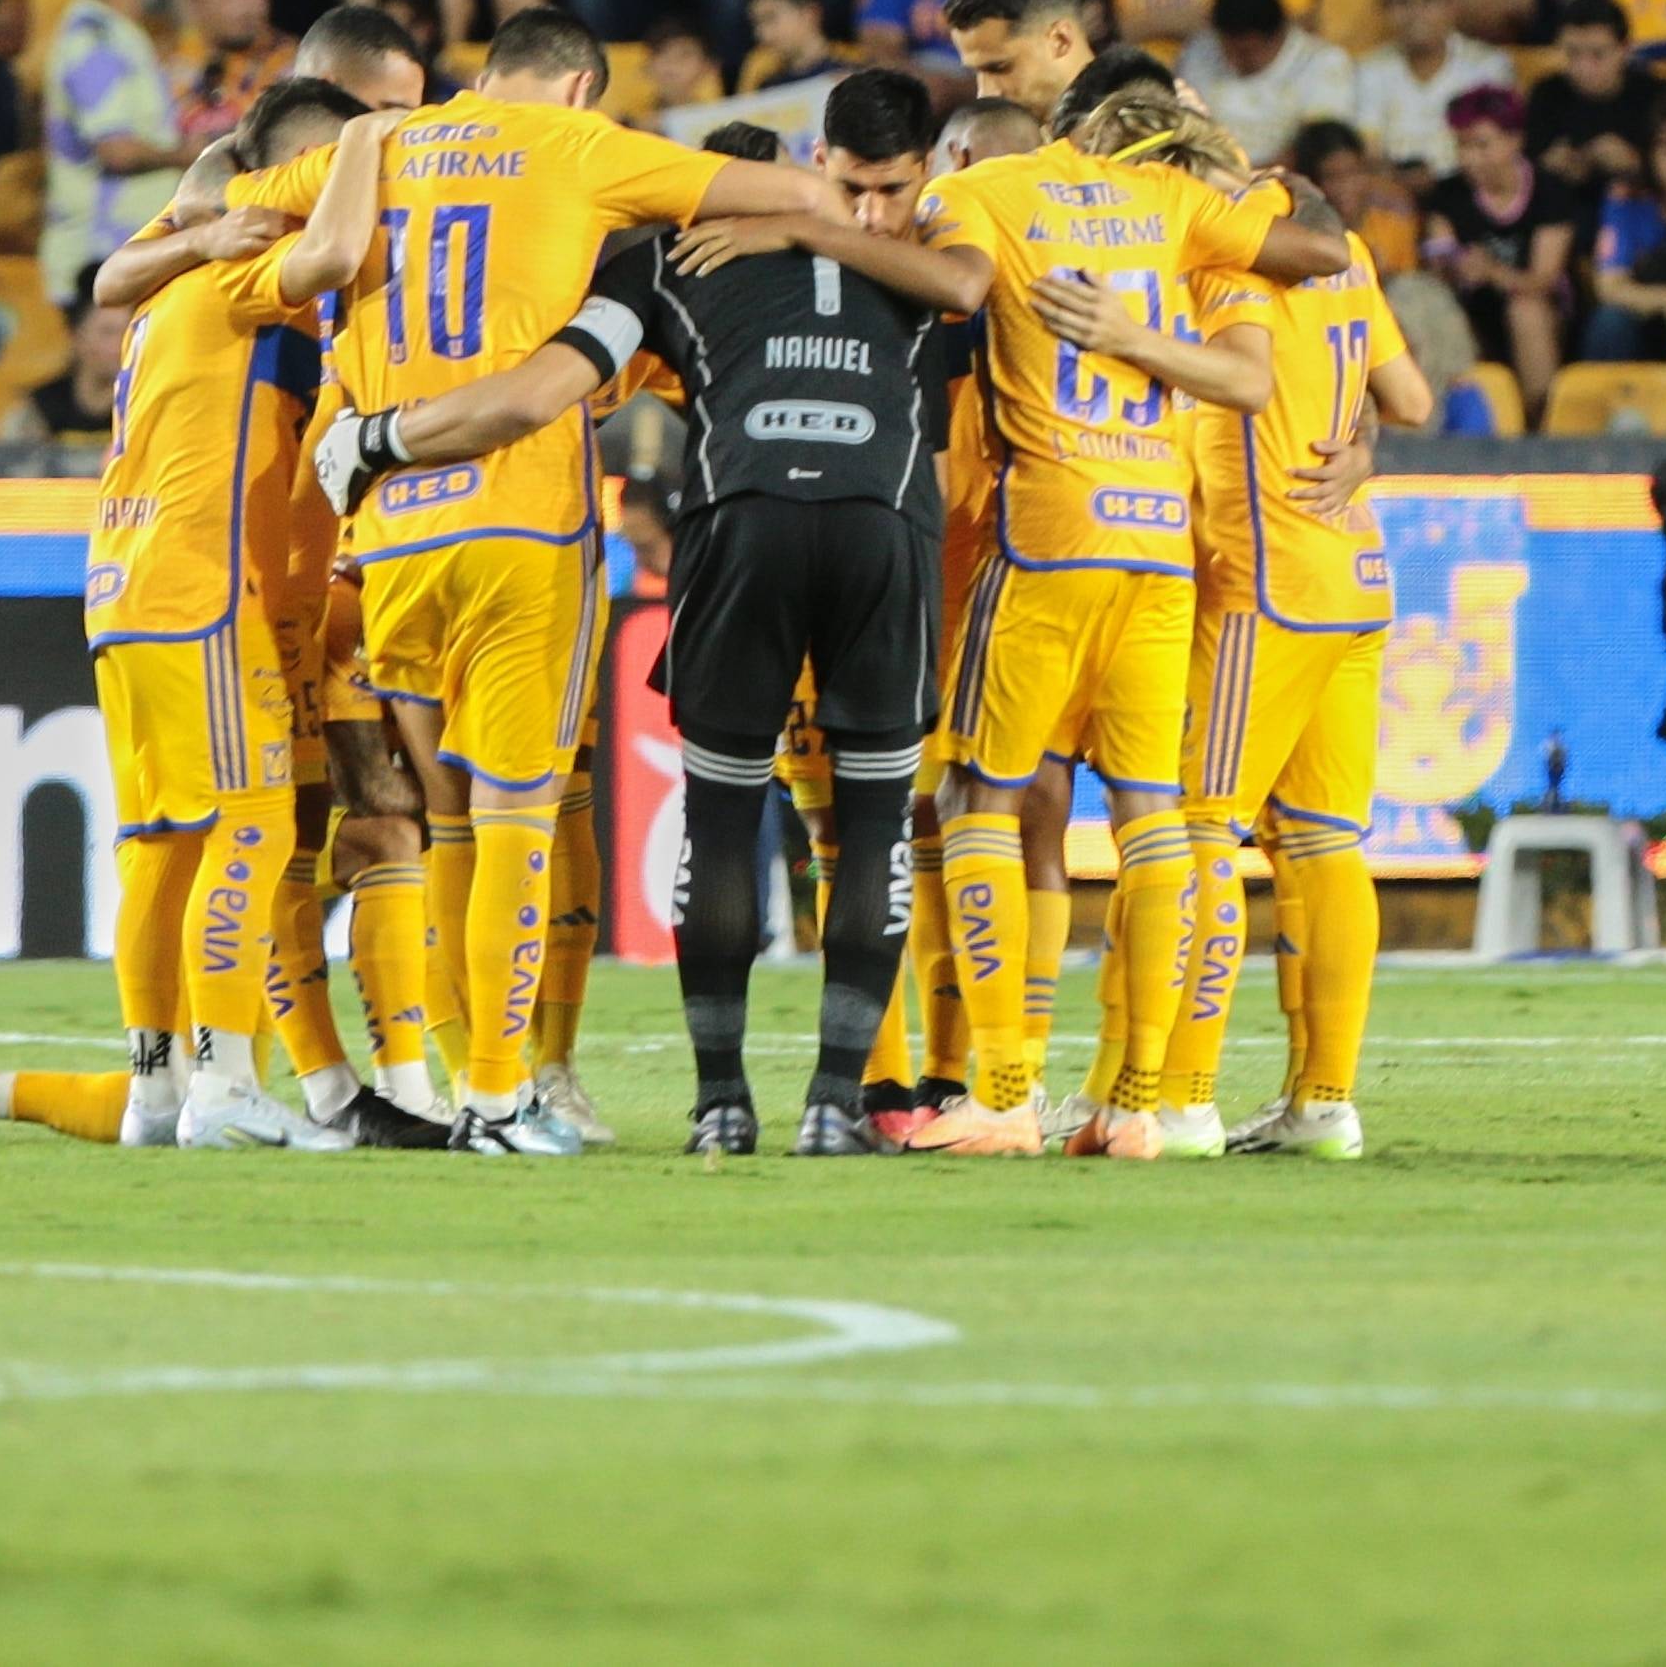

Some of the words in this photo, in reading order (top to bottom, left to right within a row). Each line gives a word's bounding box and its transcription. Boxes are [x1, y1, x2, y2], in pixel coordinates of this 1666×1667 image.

[397, 150, 527, 179] AFIRME
[1068, 214, 1167, 247] AFIRME
[380, 203, 492, 365] 10
[765, 336, 873, 375] NAHUEL
[203, 888, 248, 972] viva
[959, 883, 1002, 982] viva
[502, 940, 541, 1038] viva
[1192, 935, 1238, 1021] viva
